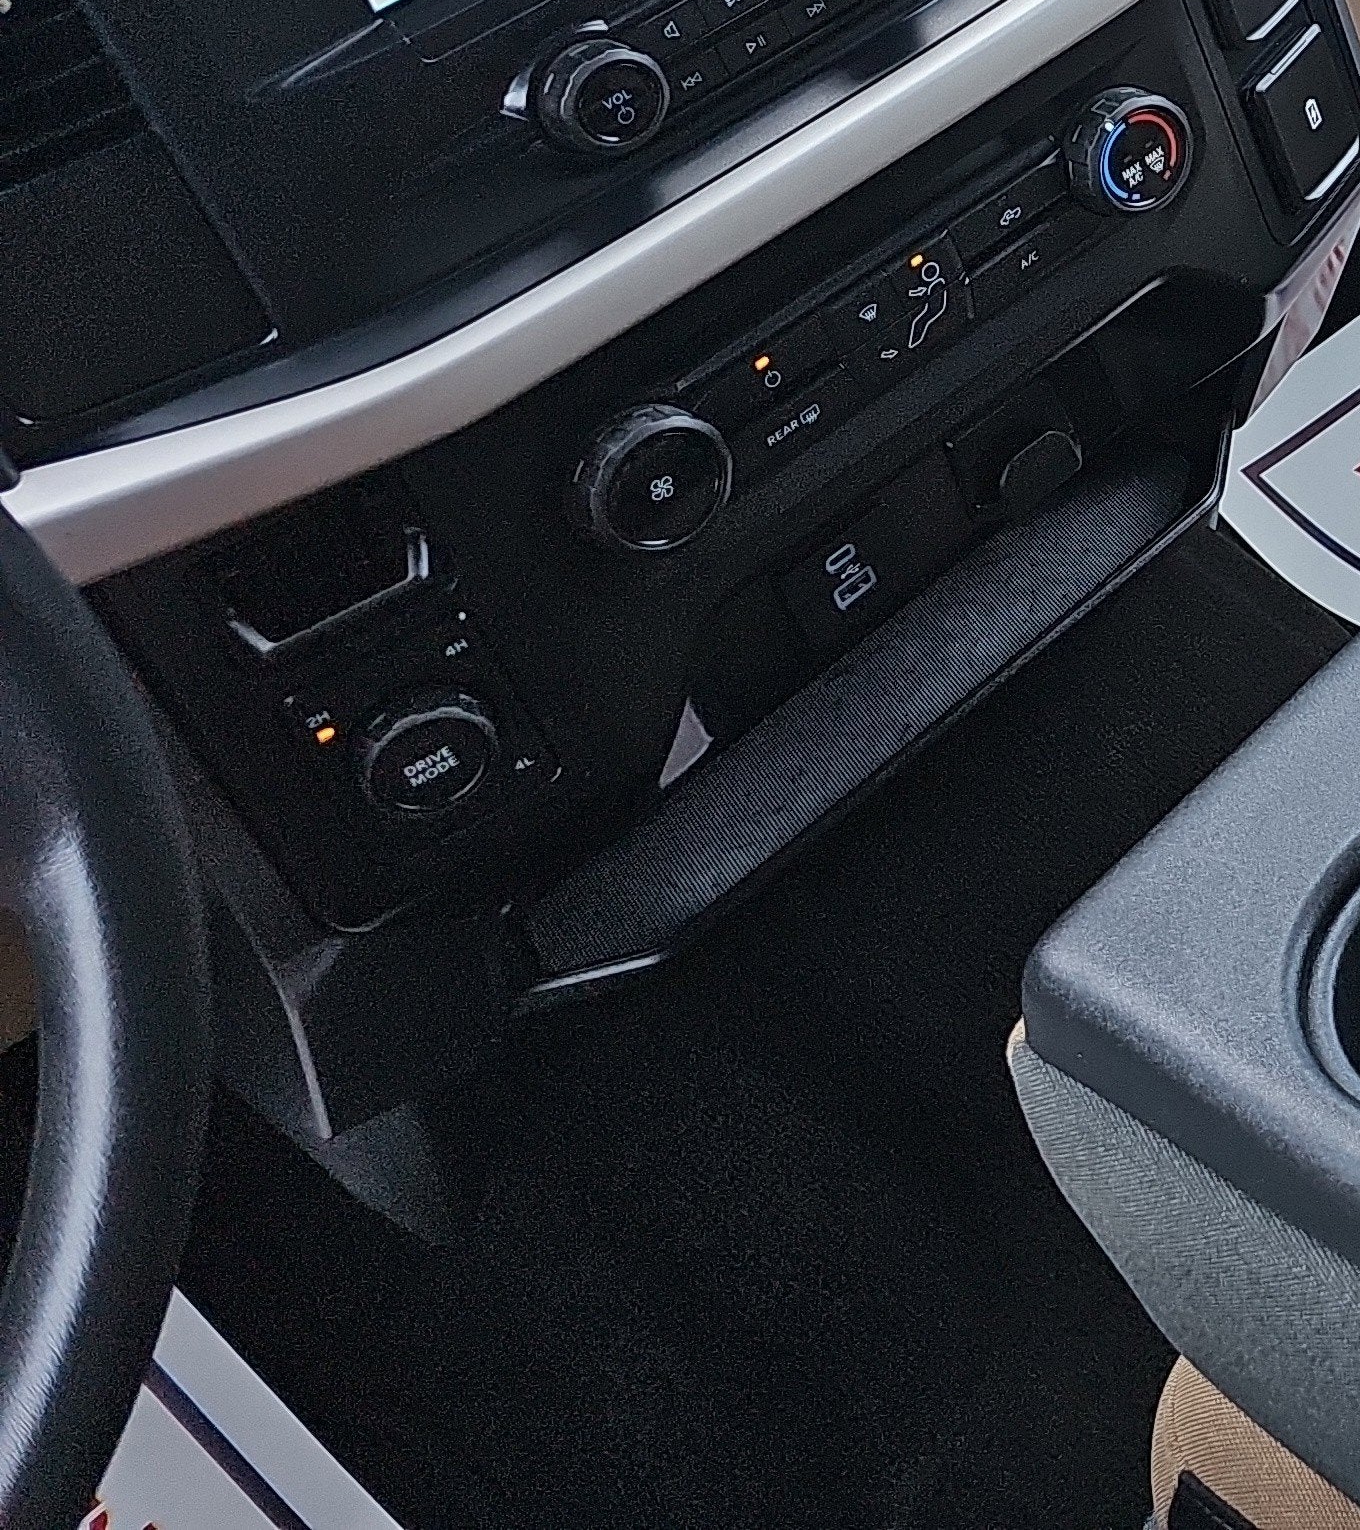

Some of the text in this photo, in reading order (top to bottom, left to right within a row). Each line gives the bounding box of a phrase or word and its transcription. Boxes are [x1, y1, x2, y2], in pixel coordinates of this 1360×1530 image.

[602, 88, 632, 111] VOL
[1145, 145, 1165, 166] MAX
[1121, 161, 1143, 181] MAX
[1128, 172, 1144, 189] A/C
[1021, 250, 1040, 270] A/C
[766, 419, 800, 447] REAR
[445, 638, 469, 657] 4H
[304, 710, 331, 729] 2H
[403, 745, 454, 778] DRIVE
[409, 754, 461, 788] MODE
[514, 756, 536, 770] 4L
